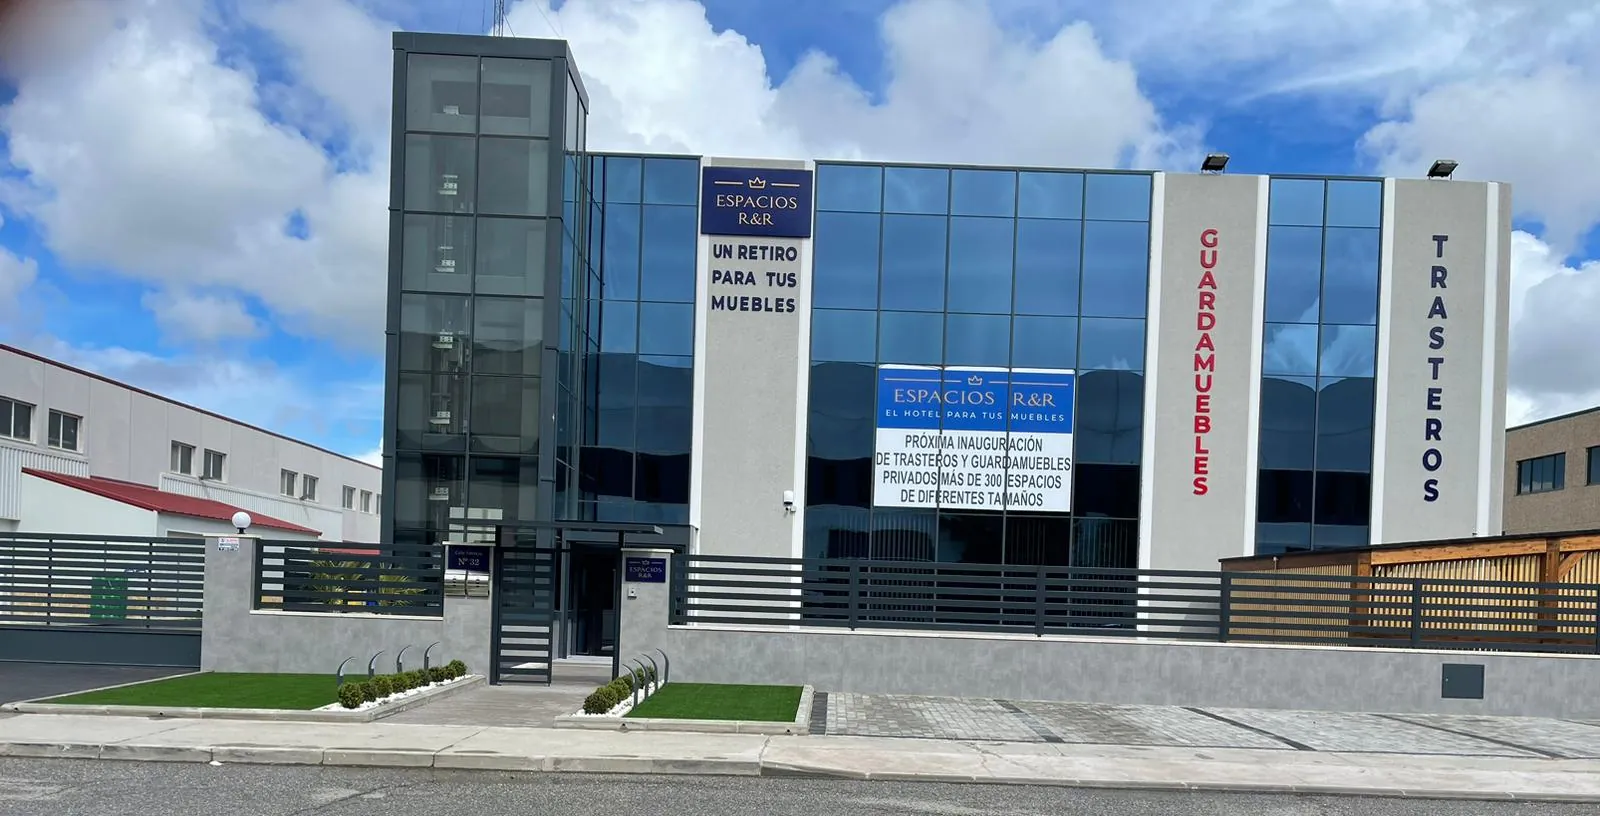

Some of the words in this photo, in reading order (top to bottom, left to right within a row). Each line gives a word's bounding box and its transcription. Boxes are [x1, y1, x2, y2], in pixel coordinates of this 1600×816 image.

[716, 194, 798, 209] ESPACIOS
[738, 212, 774, 225] R&R
[713, 244, 733, 260] UN
[738, 245, 798, 261] RETIRO
[712, 270, 756, 285] PARA
[766, 271, 797, 287] TUS
[711, 295, 796, 313] MUEBLES
[1192, 228, 1219, 496] GUARDAMUEBLES
[1422, 234, 1449, 502] TRASTEROS
[894, 388, 995, 406] ESPACIOS
[1013, 392, 1056, 408] R&R
[885, 409, 898, 417] EL
[904, 410, 941, 418] HOTEL
[947, 411, 977, 419] PARA
[983, 412, 1003, 420] TUS
[1010, 413, 1065, 422] MUEBLES
[904, 432, 955, 450] PRÓXIMA
[957, 434, 1043, 452] INAUGURACIÓN
[876, 452, 890, 466] DE
[893, 452, 959, 468] TRASTEROS
[961, 454, 969, 468] Y
[971, 454, 1071, 471] GUARDAMUEBLES
[883, 470, 938, 486] PRIVADOS
[941, 469, 965, 486] MÁS
[967, 473, 982, 487] DE
[984, 473, 1002, 487] 300
[1007, 474, 1062, 489] ESPACIOS
[900, 489, 915, 503] DE
[918, 489, 985, 505] DIFERENTES
[988, 490, 1043, 507] TAMAÑOS
[470, 558, 480, 566] 32
